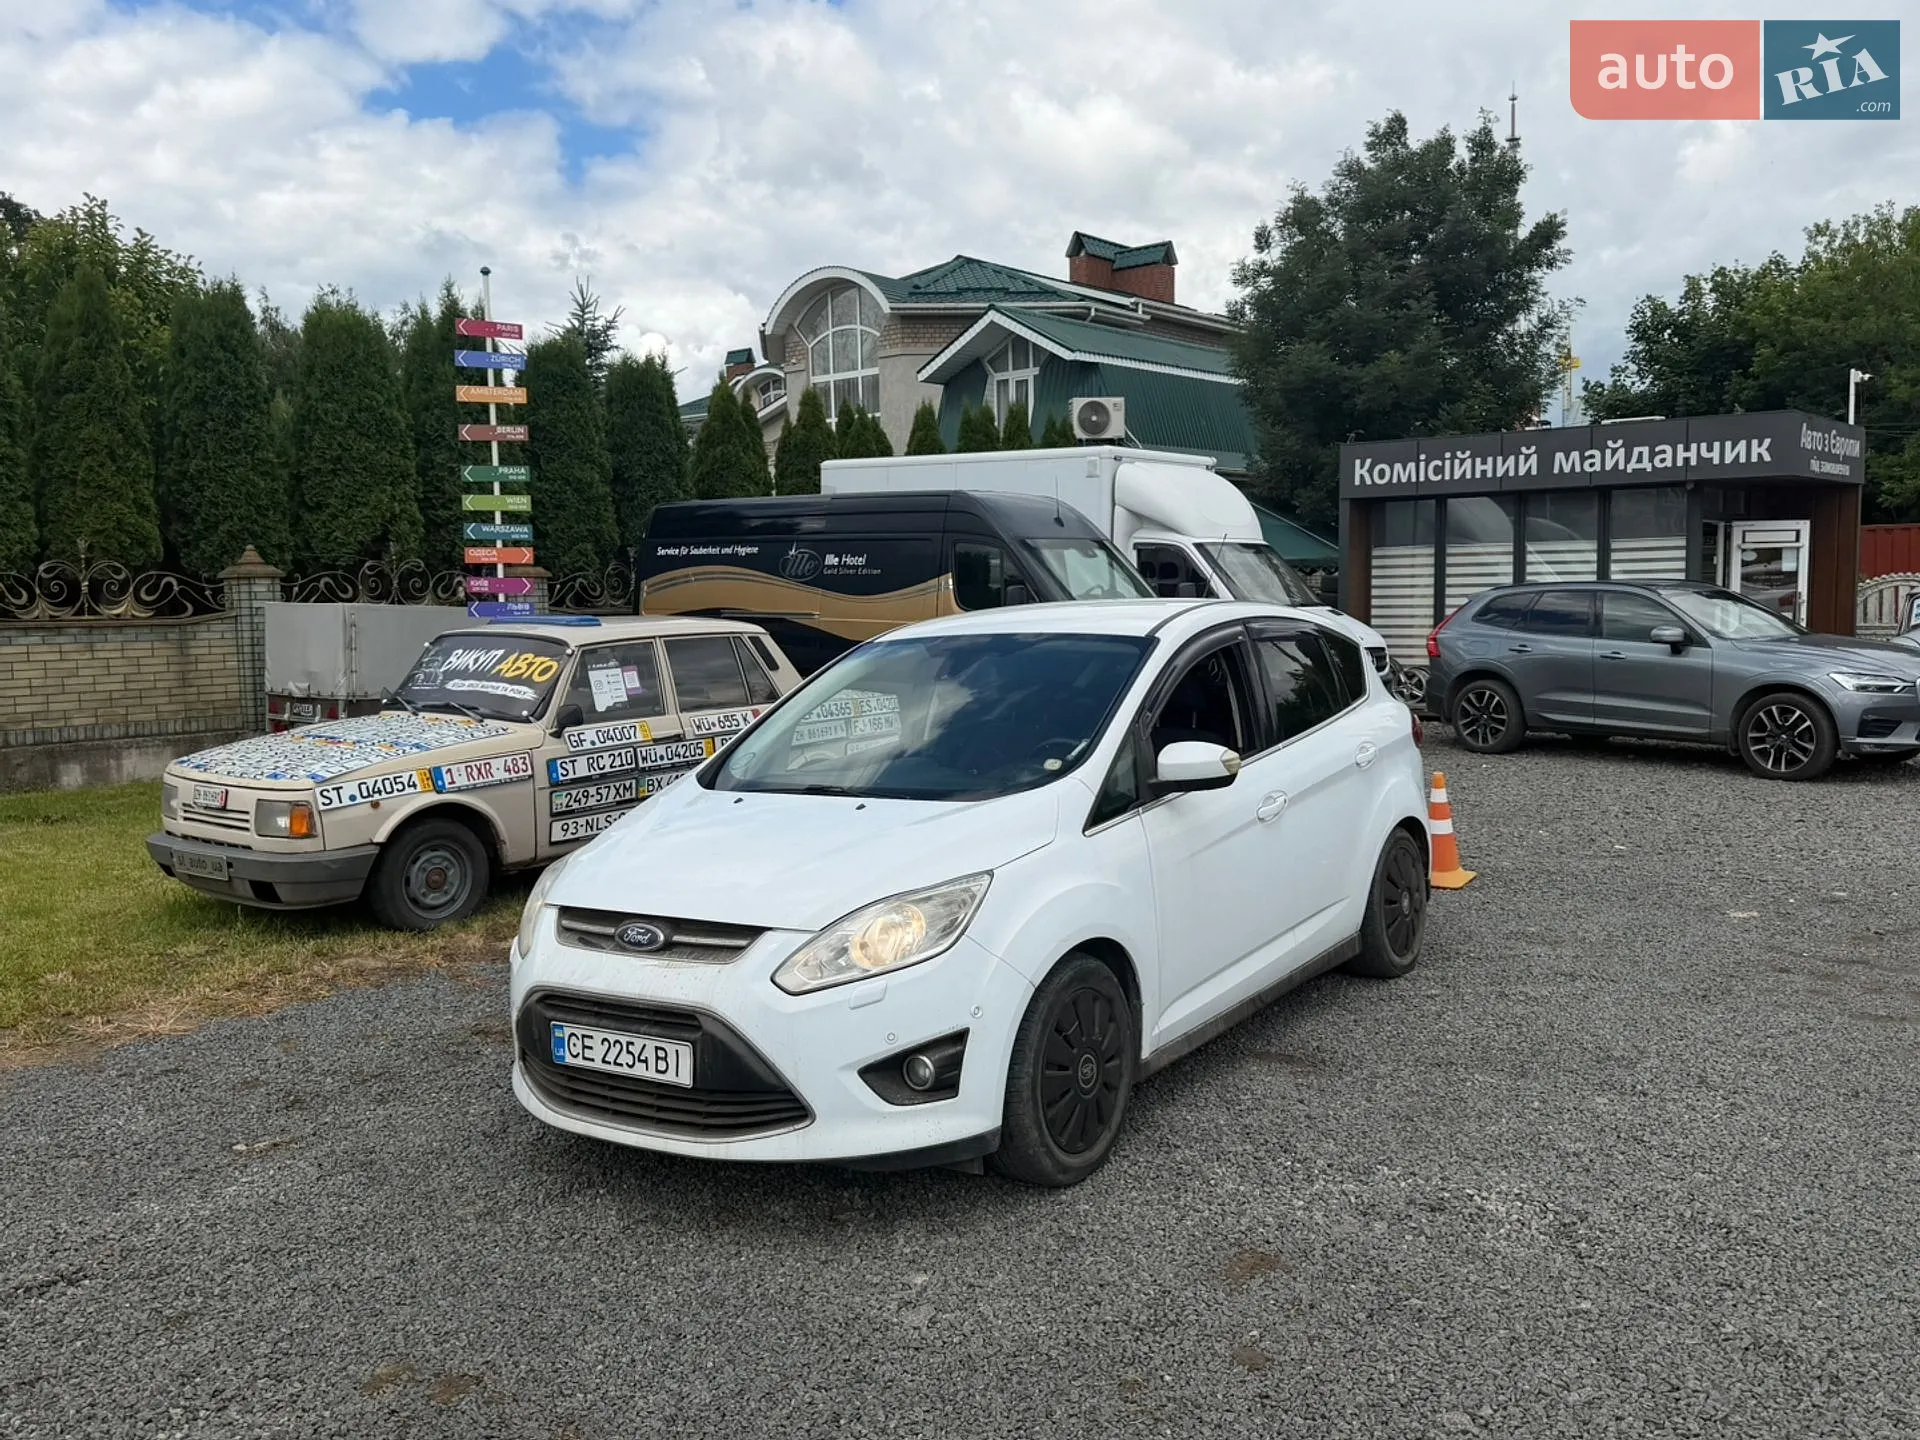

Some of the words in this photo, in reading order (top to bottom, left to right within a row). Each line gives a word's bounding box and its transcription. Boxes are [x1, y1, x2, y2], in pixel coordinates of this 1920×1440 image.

[1800, 422, 1823, 451] Авто
[1353, 445, 1539, 486] Комісійний
[1553, 437, 1772, 473] майданчик
[841, 553, 867, 565] Hotel
[440, 648, 506, 673] ВИКУП
[487, 651, 560, 684] АВТО
[665, 740, 704, 761] 04205
[559, 759, 577, 778] ST
[586, 753, 606, 773] RC
[319, 785, 344, 807] ST
[623, 927, 652, 944] Ford
[567, 1032, 596, 1062] CE
[600, 1037, 649, 1072] 2254
[654, 1045, 680, 1078] BI
